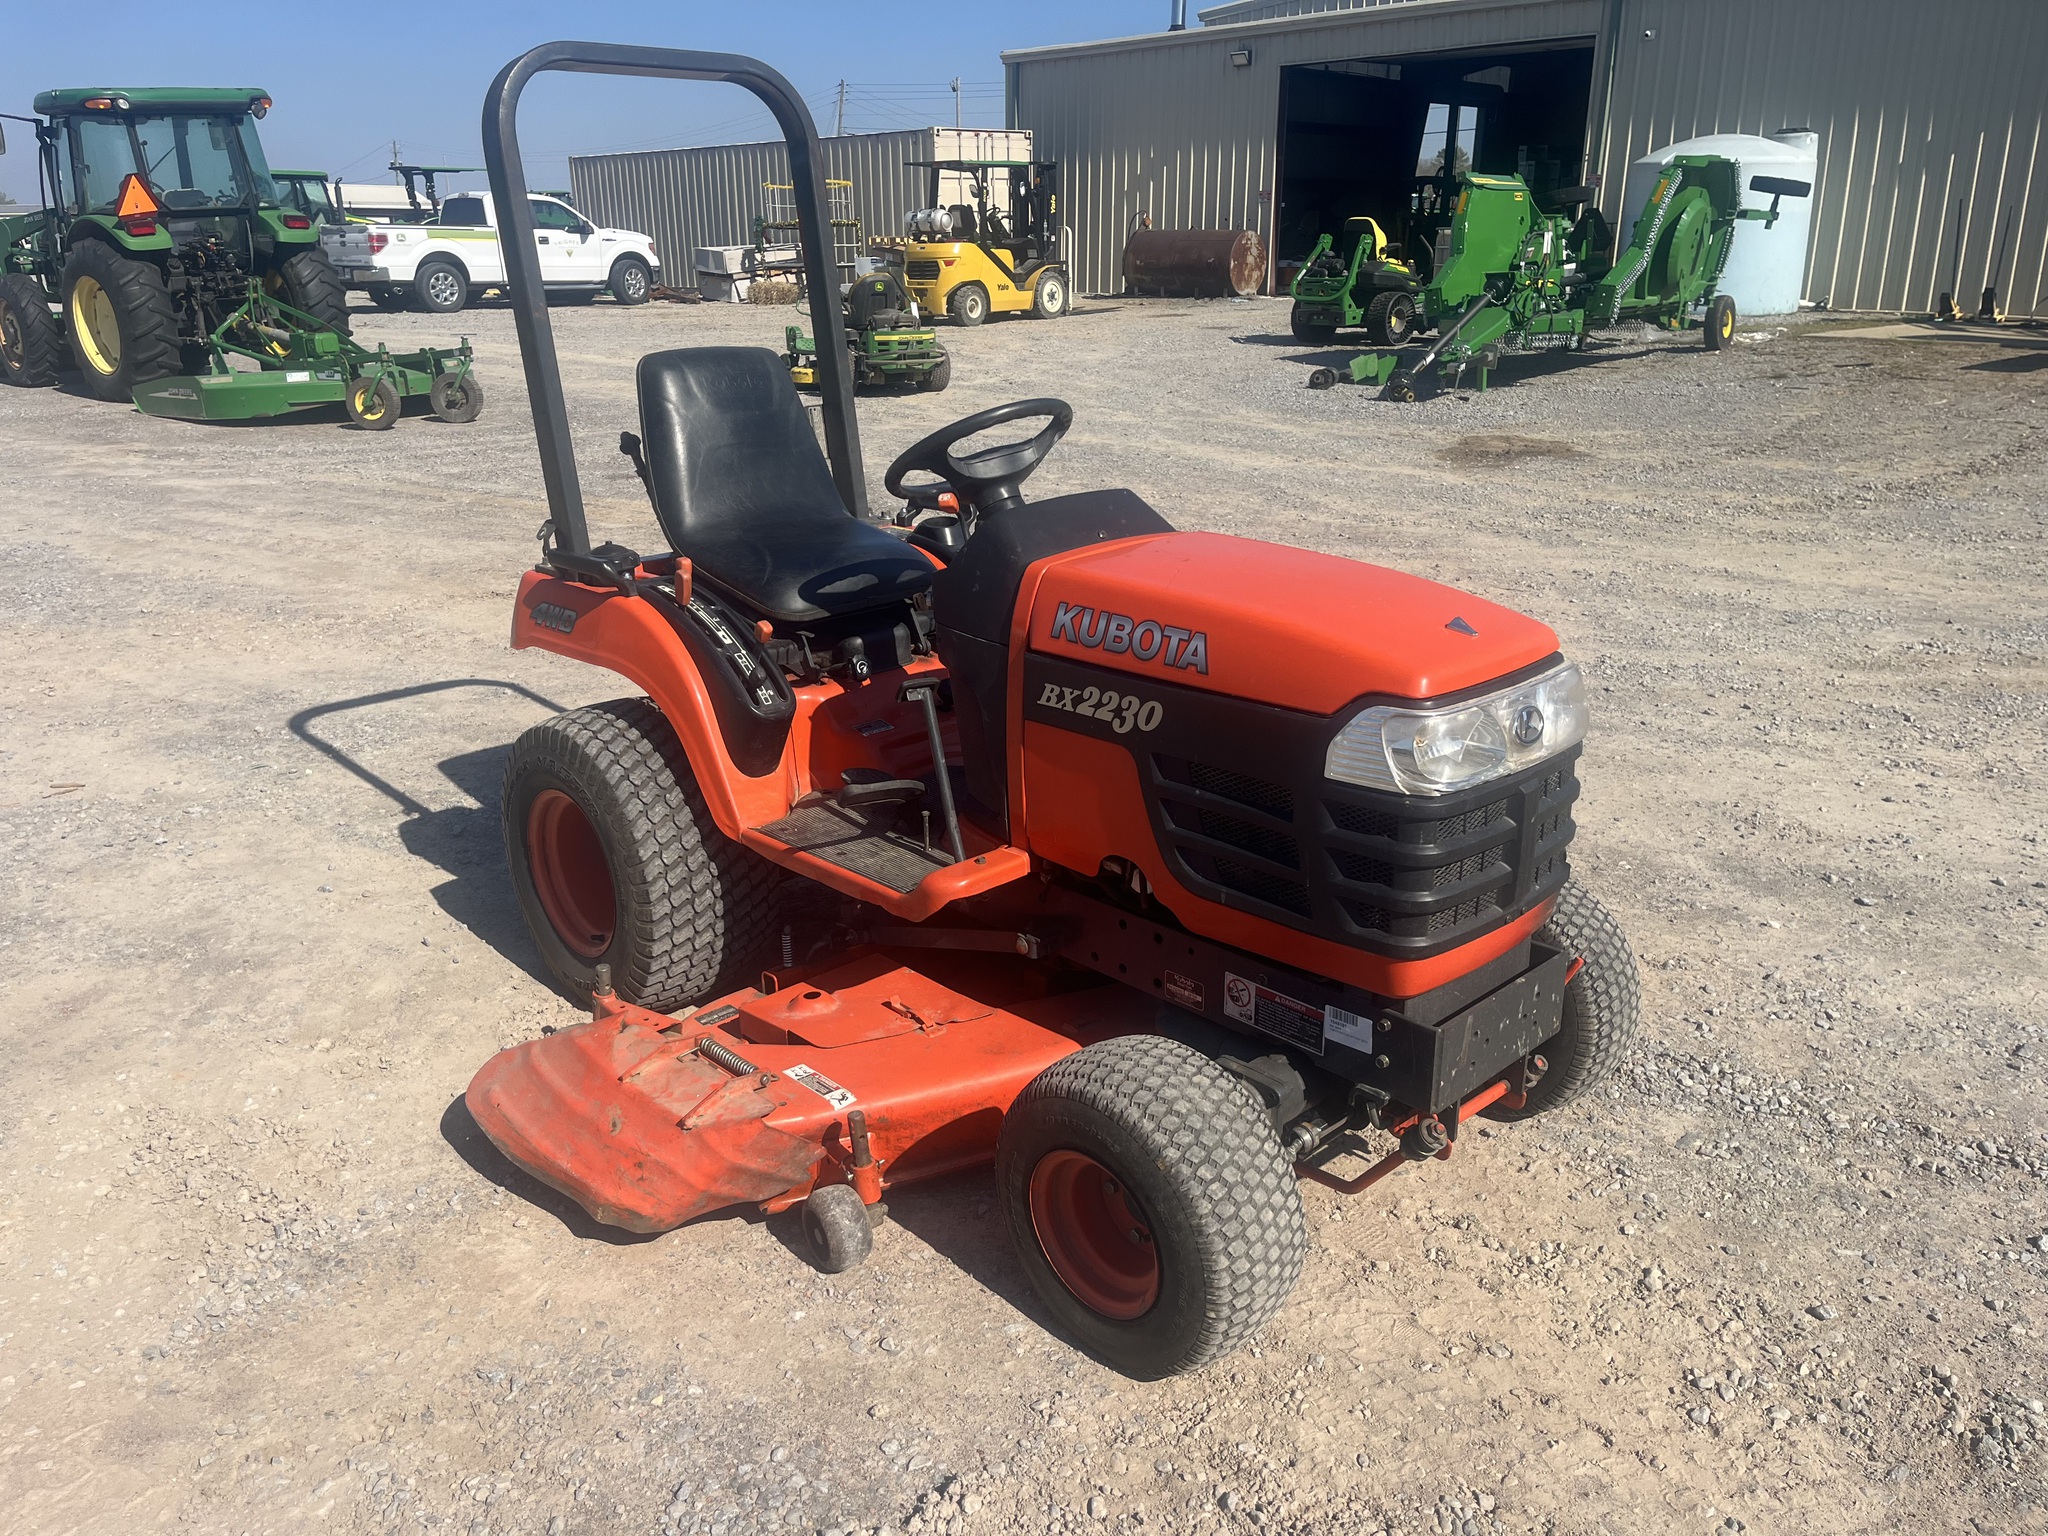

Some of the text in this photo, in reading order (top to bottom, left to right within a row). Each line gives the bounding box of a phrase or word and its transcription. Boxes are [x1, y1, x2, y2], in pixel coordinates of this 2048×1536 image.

[997, 283, 1010, 291] Yale
[529, 601, 577, 633] 4WD
[1050, 601, 1209, 676] KUBOTA
[1036, 682, 1164, 734] BX2230
[1280, 998, 1306, 1012] DANGER
